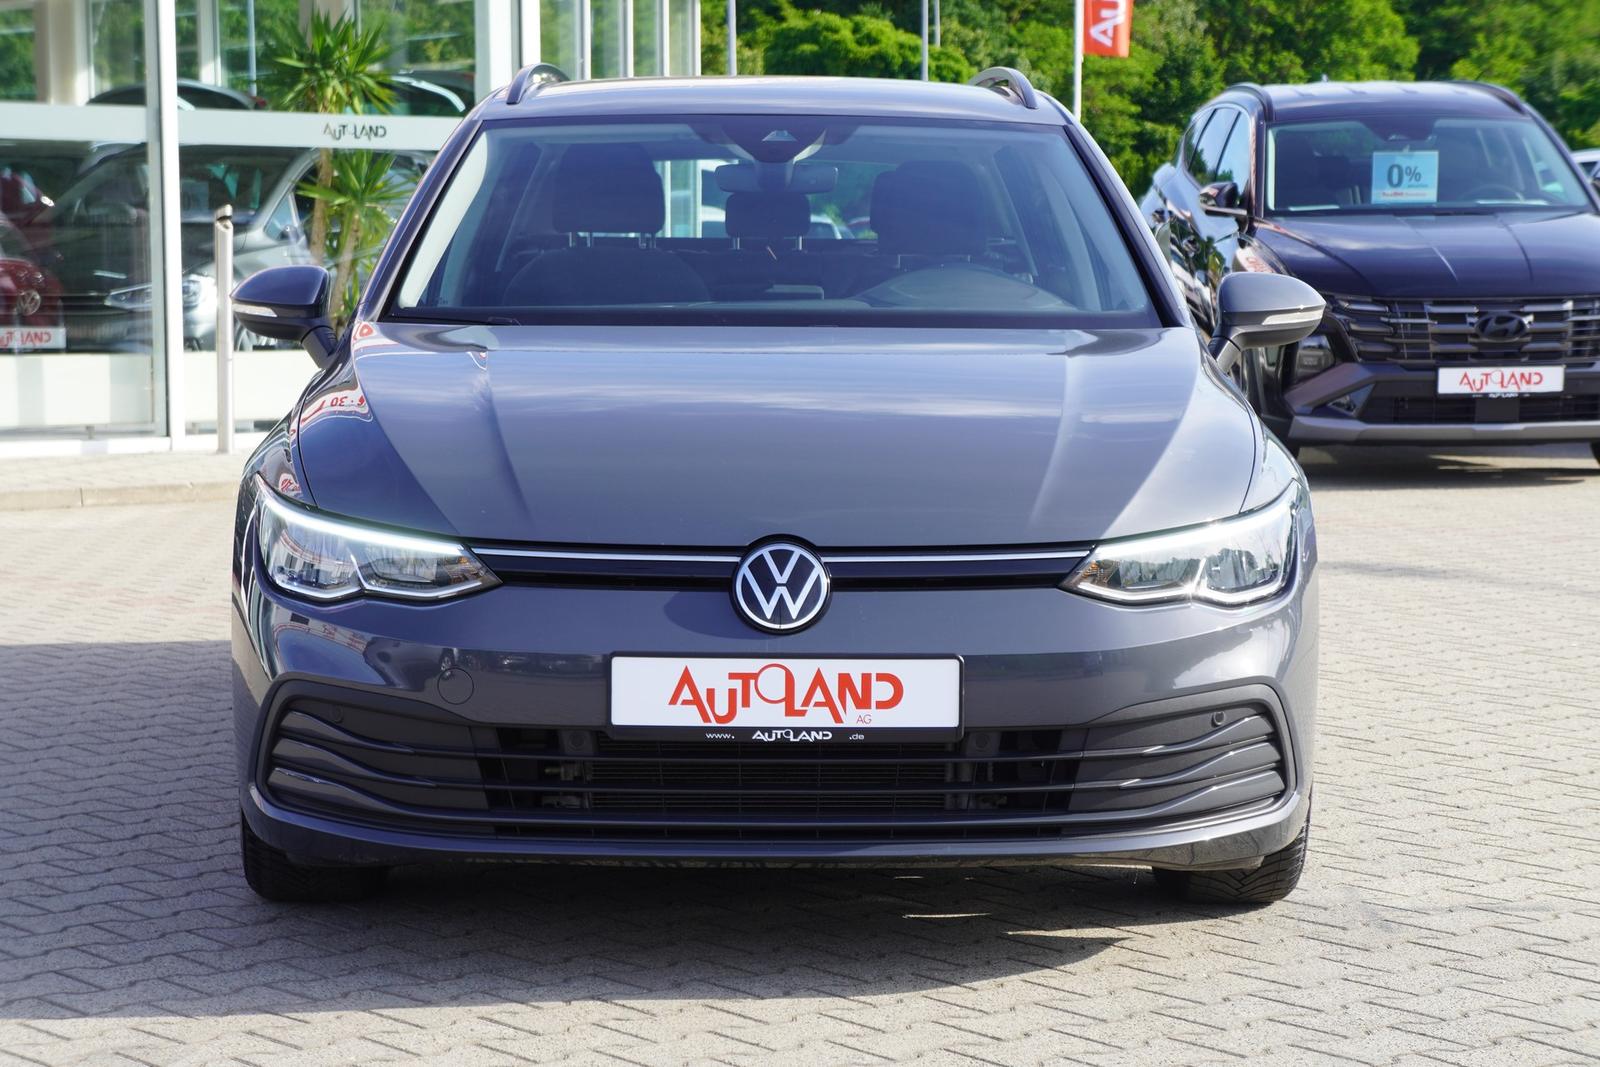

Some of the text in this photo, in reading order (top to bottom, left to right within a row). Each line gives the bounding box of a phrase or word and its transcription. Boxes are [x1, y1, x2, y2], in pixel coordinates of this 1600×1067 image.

[323, 123, 387, 141] AUTLAND
[1387, 164, 1422, 188] 0%
[1460, 370, 1543, 391] AUTOLAND
[668, 663, 904, 724] AUTOLAND
[856, 714, 872, 724] AG
[752, 729, 833, 742] AUTOLAND
